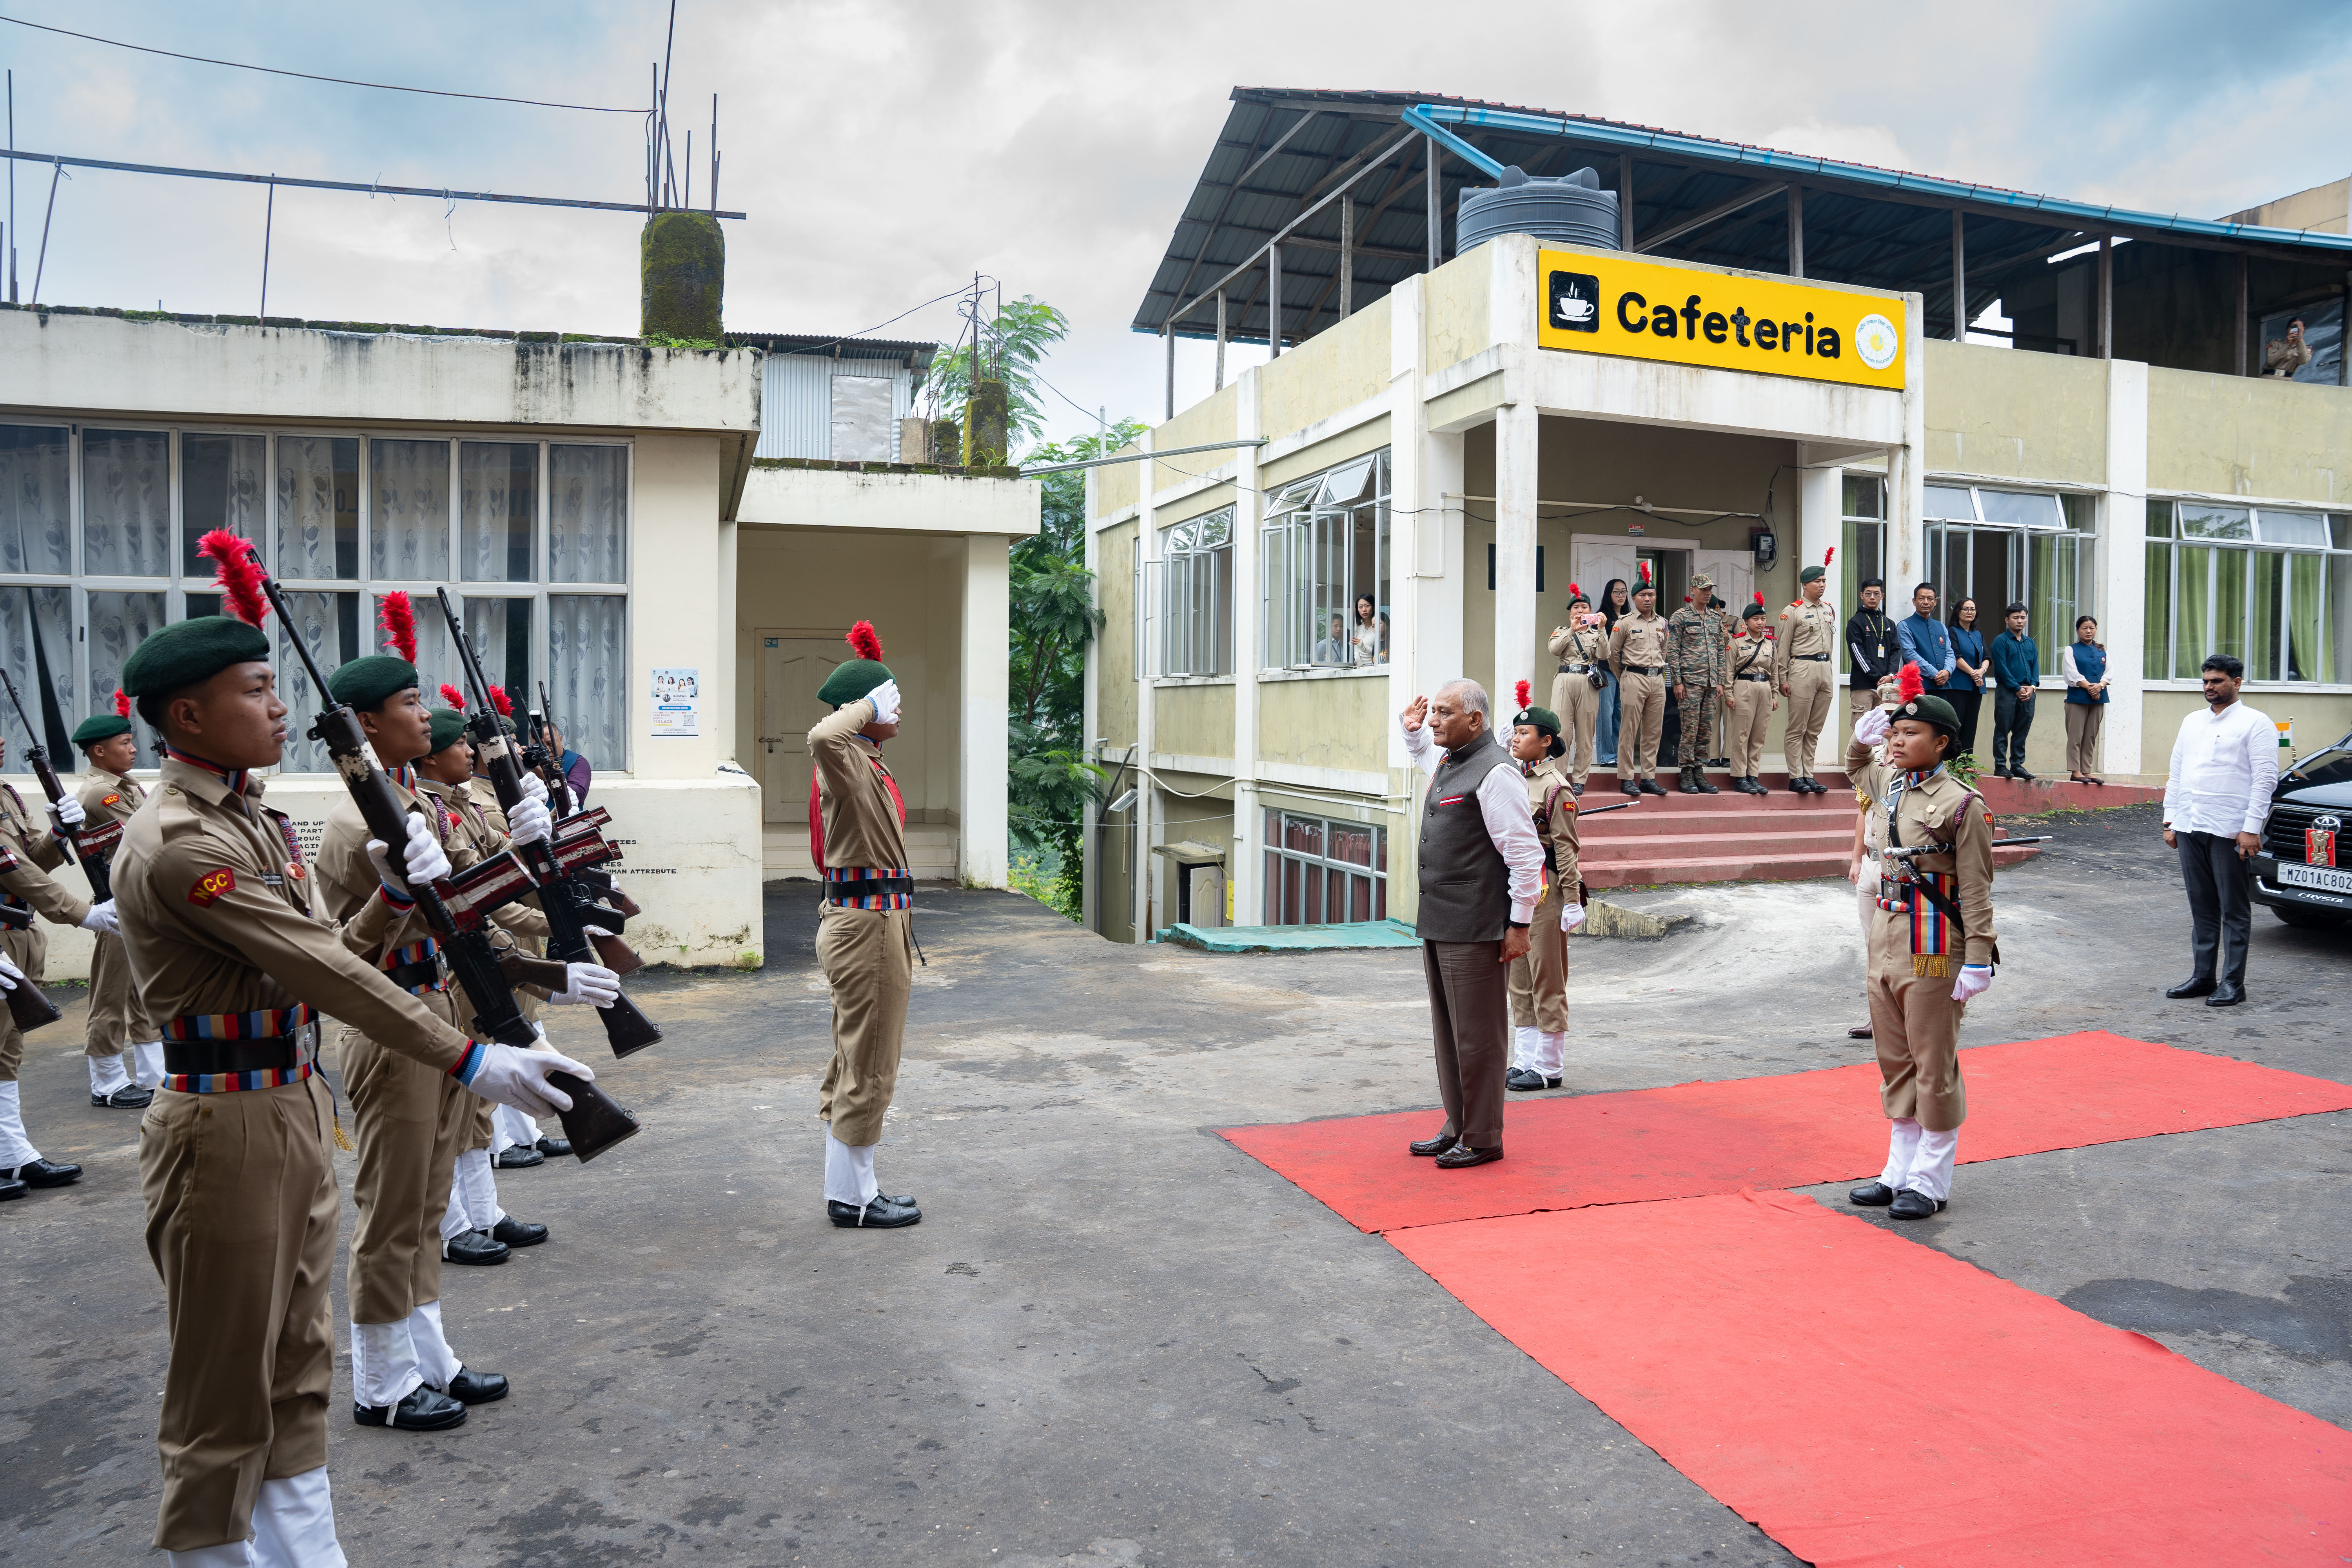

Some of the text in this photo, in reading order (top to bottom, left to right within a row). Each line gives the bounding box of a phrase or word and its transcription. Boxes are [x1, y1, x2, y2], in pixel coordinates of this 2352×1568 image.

[1617, 292, 1840, 359] Cafeteria
[104, 795, 118, 805] NCC
[194, 874, 228, 900] NCC
[2287, 869, 2352, 889] MZ01AC802
[2298, 893, 2345, 904] CRYSTA
